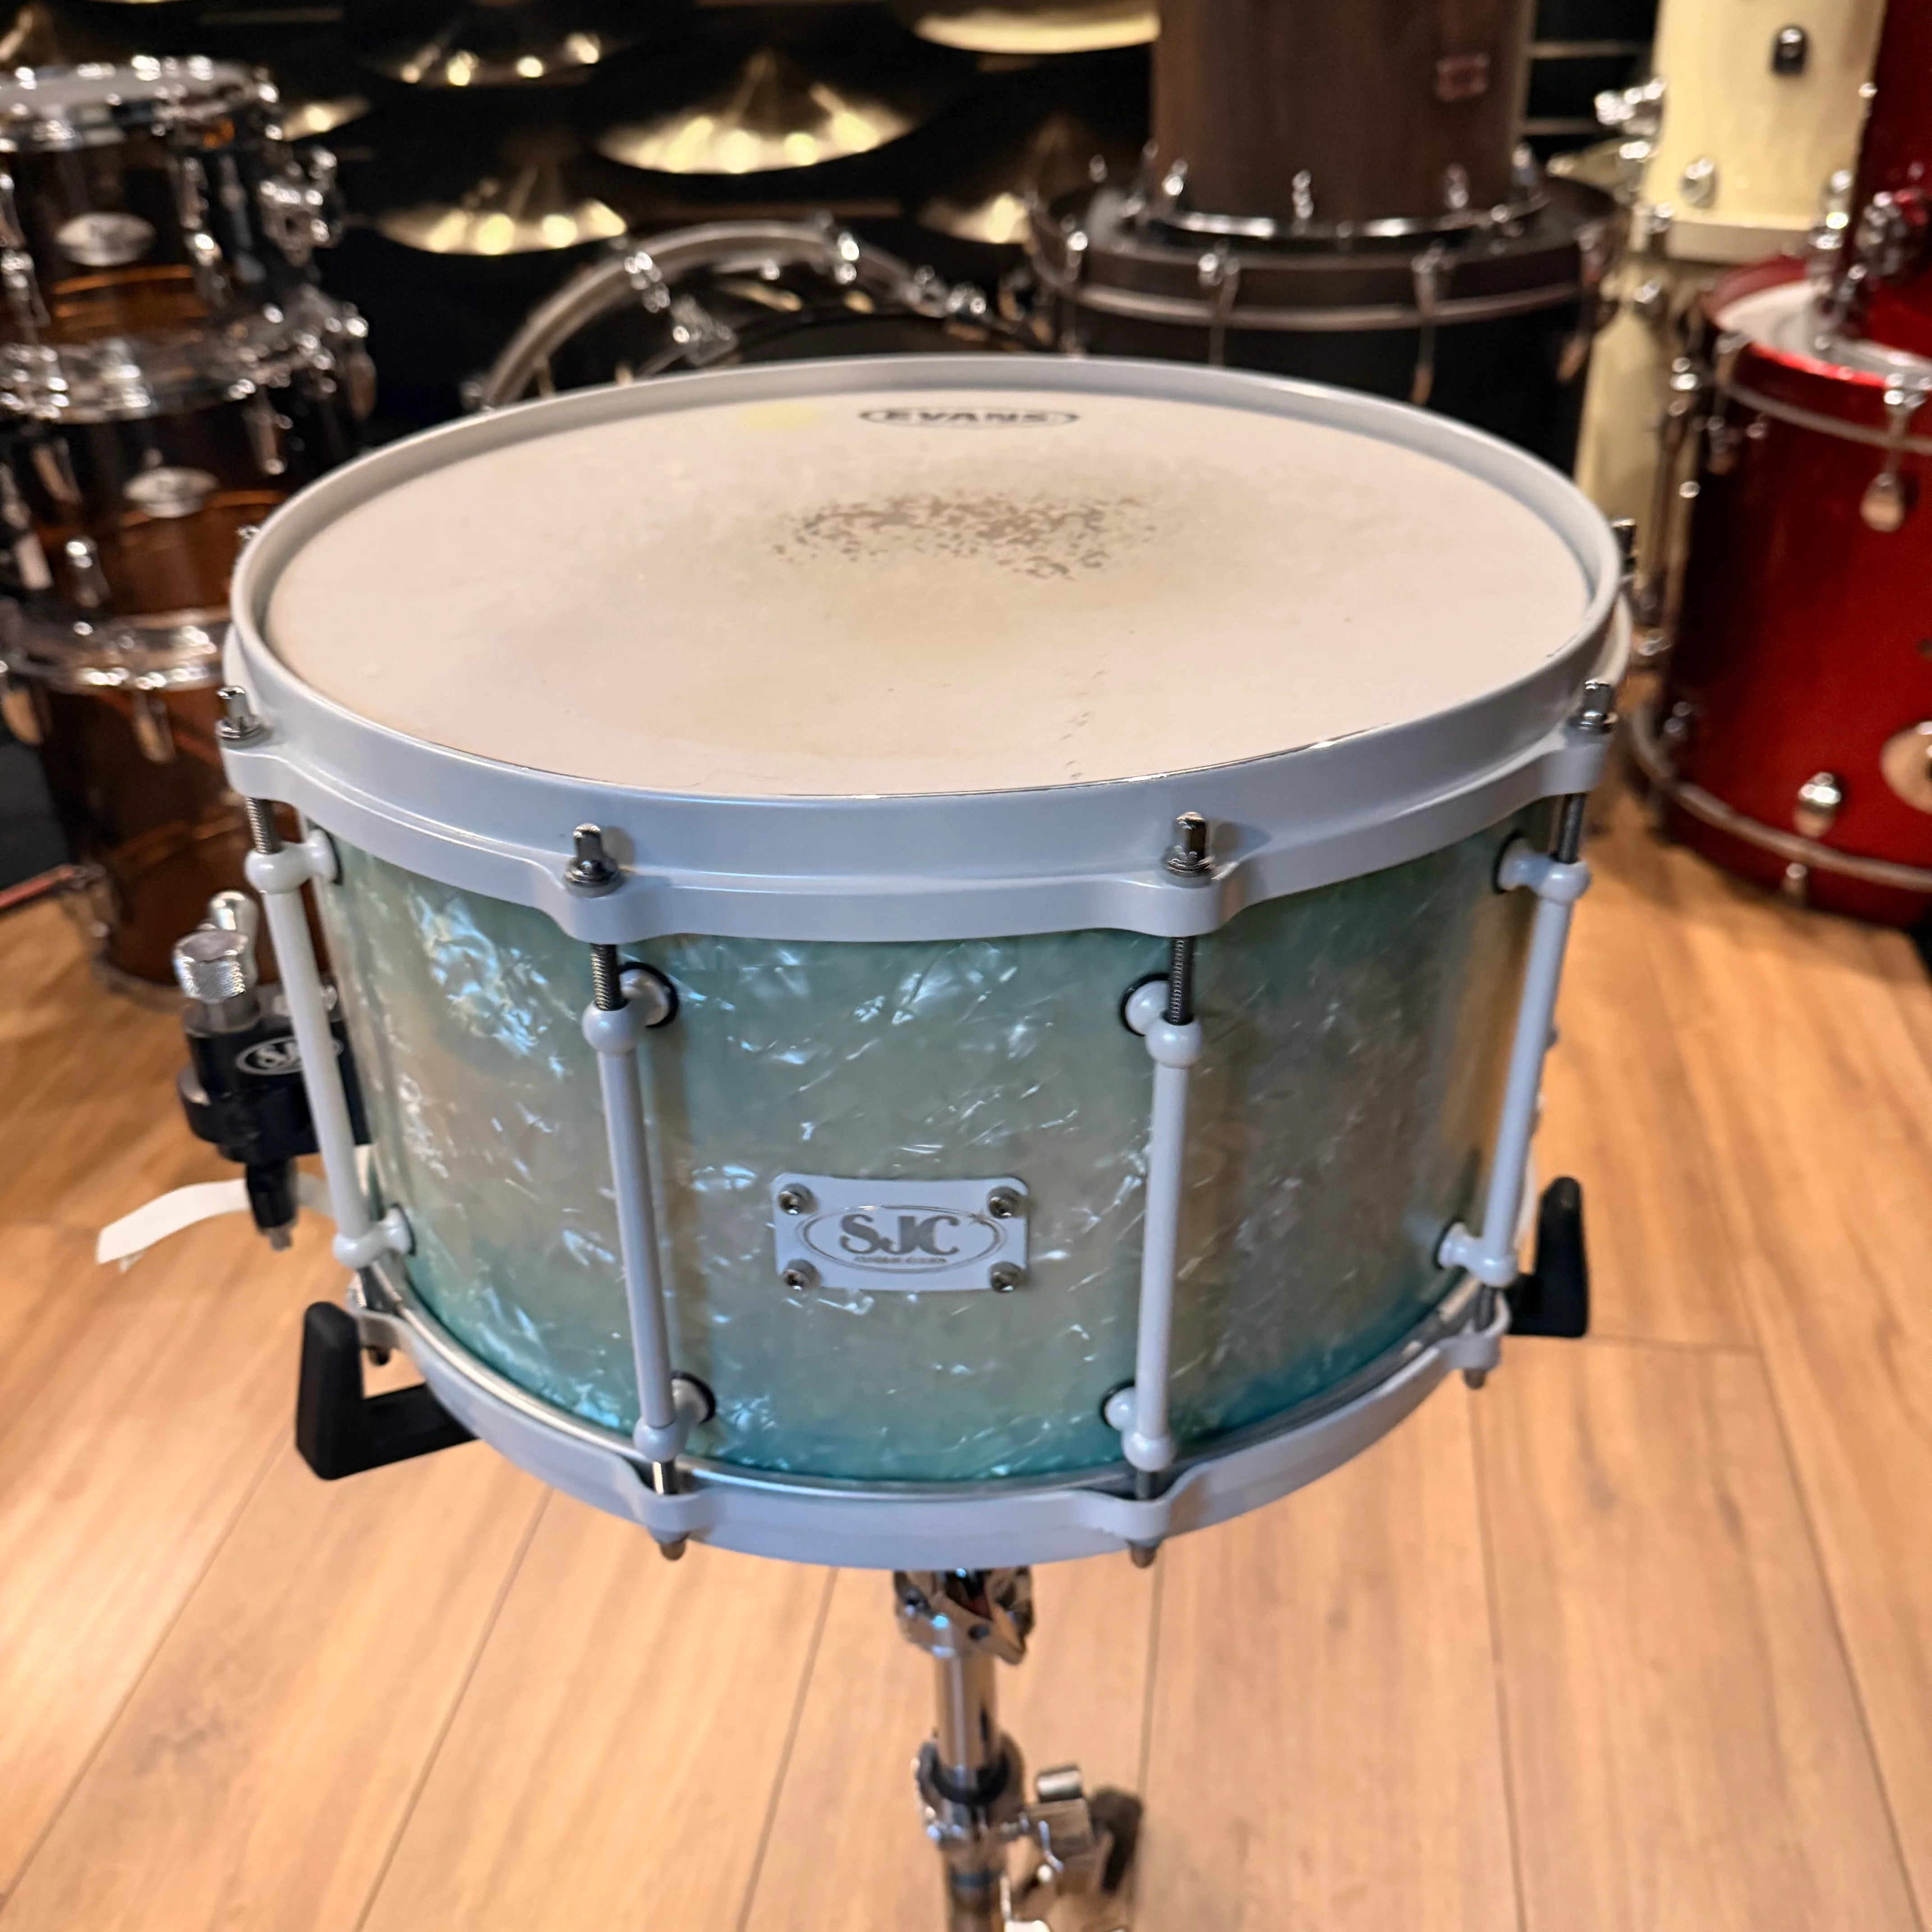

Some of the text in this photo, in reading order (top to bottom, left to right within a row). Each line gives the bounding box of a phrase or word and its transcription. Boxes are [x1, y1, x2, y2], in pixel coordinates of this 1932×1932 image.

[884, 411, 1049, 423] EVANS
[257, 1042, 302, 1069] SJ
[839, 1214, 959, 1255] SJC
